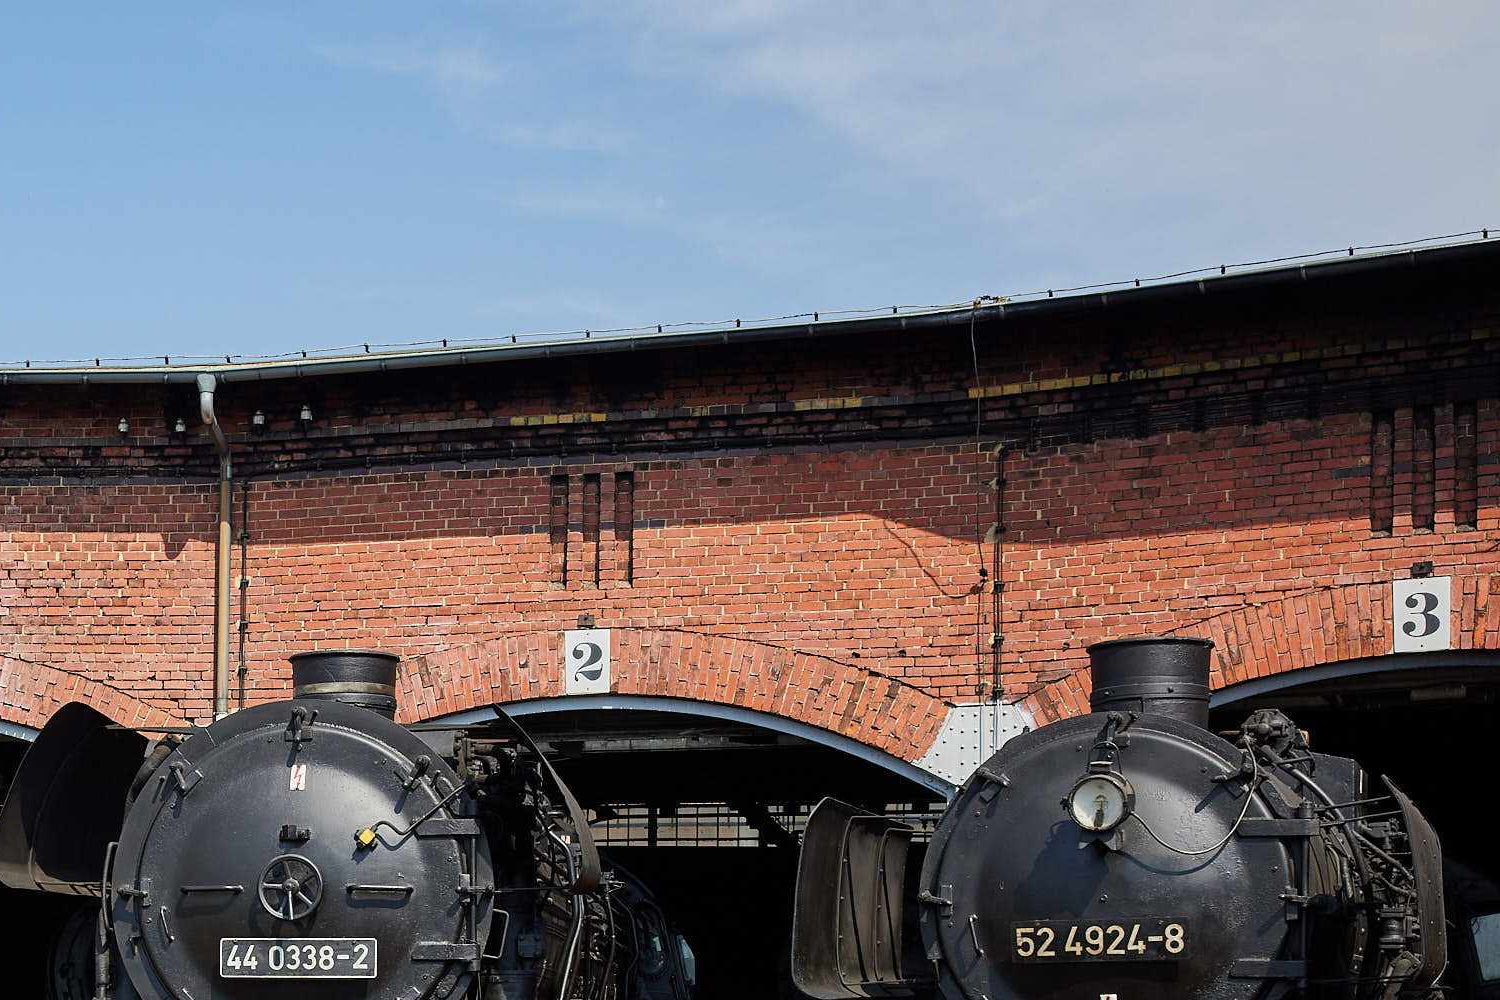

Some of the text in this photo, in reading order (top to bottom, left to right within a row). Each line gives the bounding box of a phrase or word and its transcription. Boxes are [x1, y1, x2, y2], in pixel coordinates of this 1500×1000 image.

[1402, 592, 1441, 638] 3
[572, 642, 604, 682] 2
[226, 943, 369, 971] 44 0338-2
[1015, 923, 1186, 957] 52 4924-8
